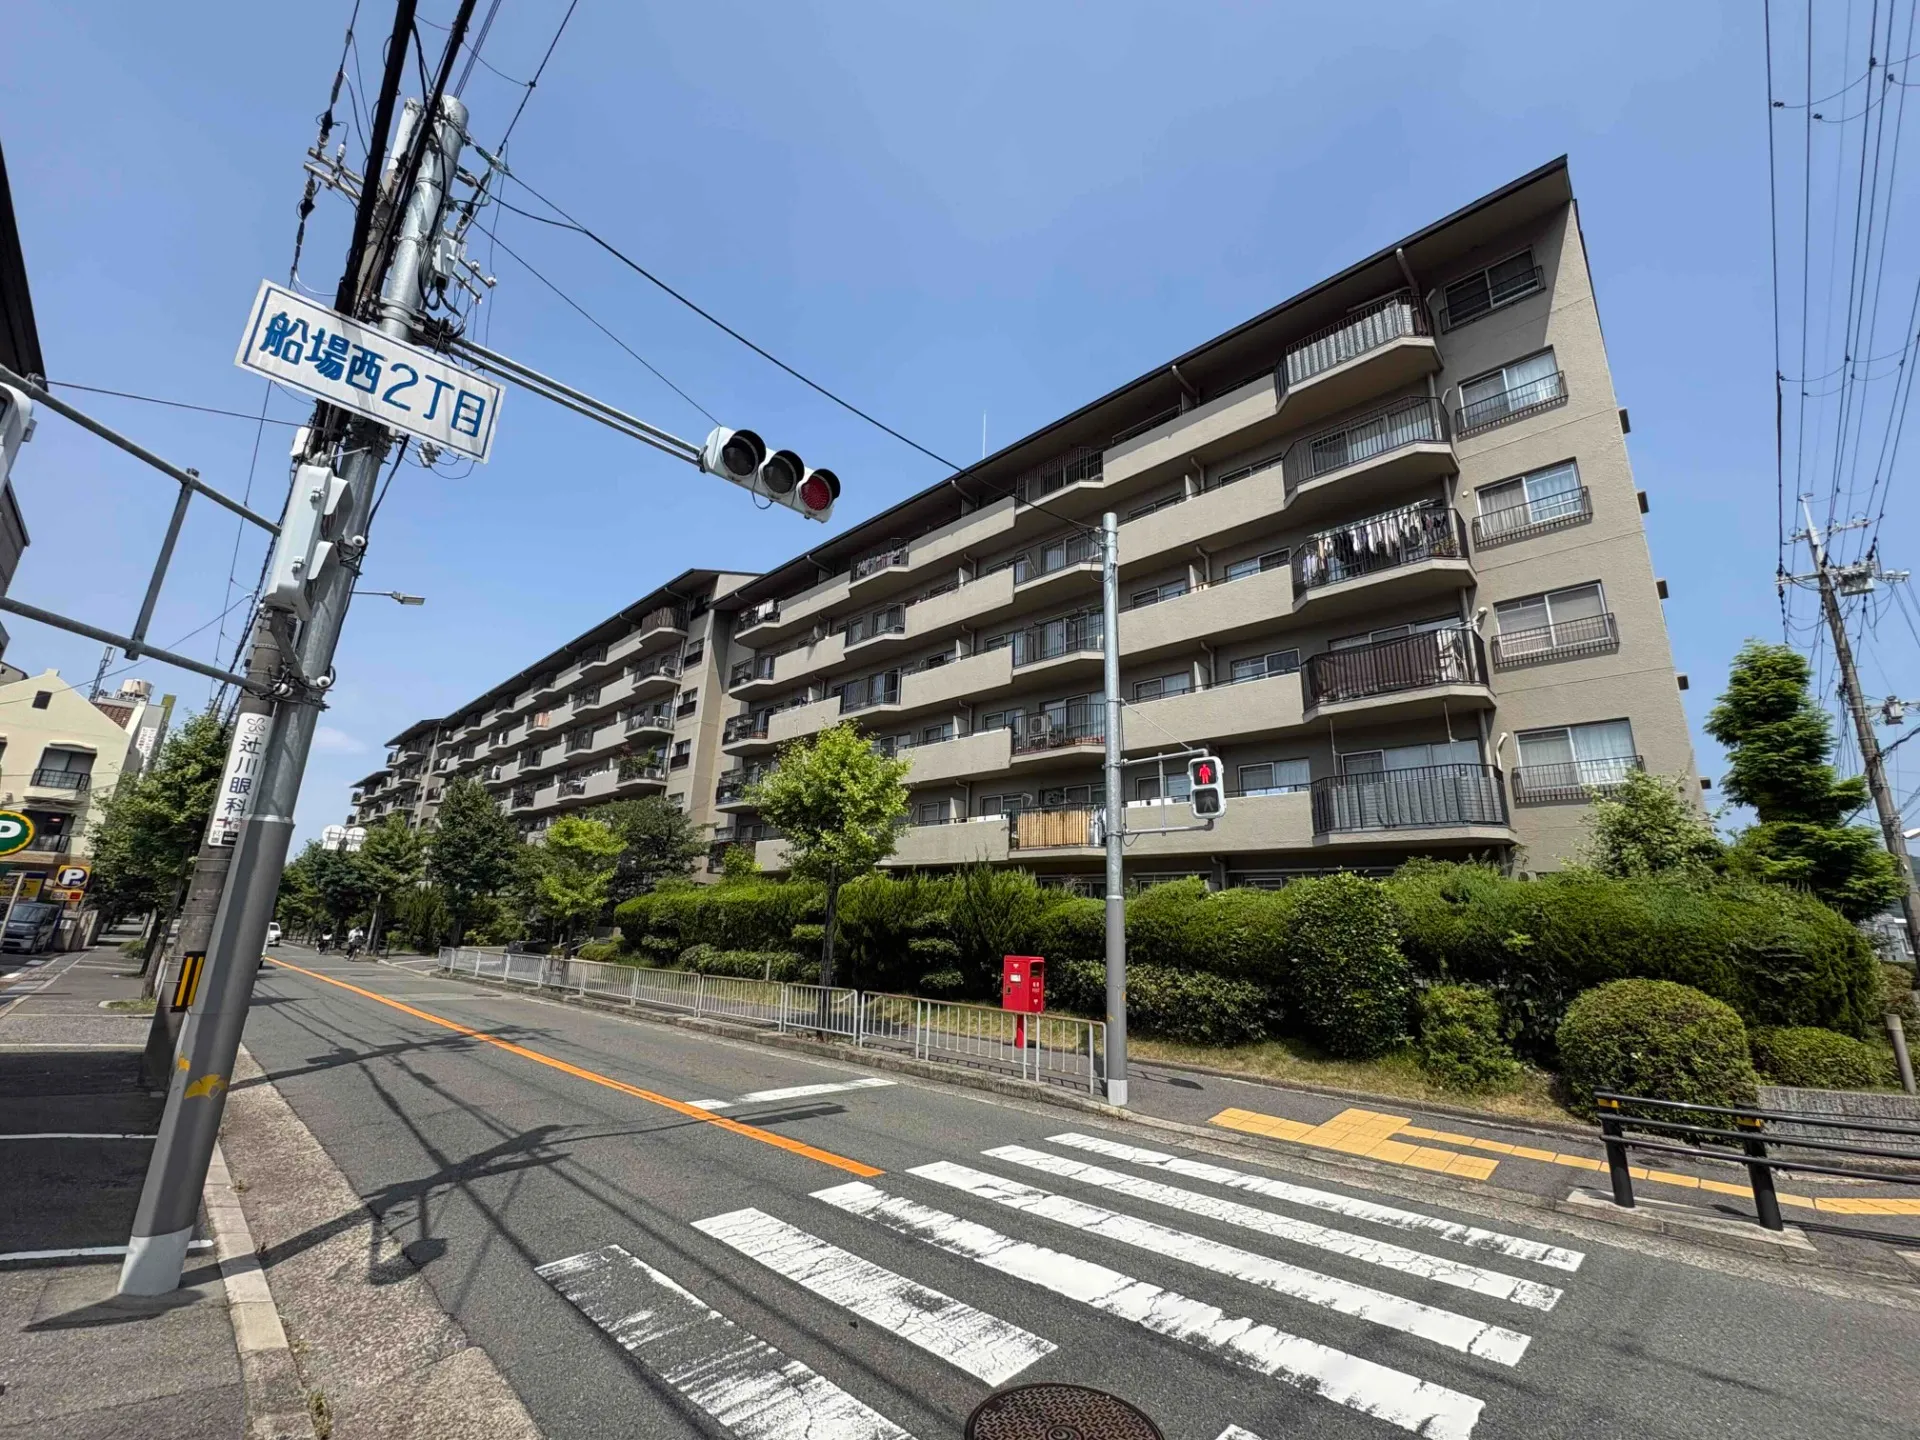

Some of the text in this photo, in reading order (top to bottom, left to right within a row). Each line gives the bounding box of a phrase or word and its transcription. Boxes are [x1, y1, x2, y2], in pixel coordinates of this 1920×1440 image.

[259, 312, 486, 437] 船場西2丁目
[224, 735, 262, 817] 辻川眼科
[62, 869, 84, 885] P
